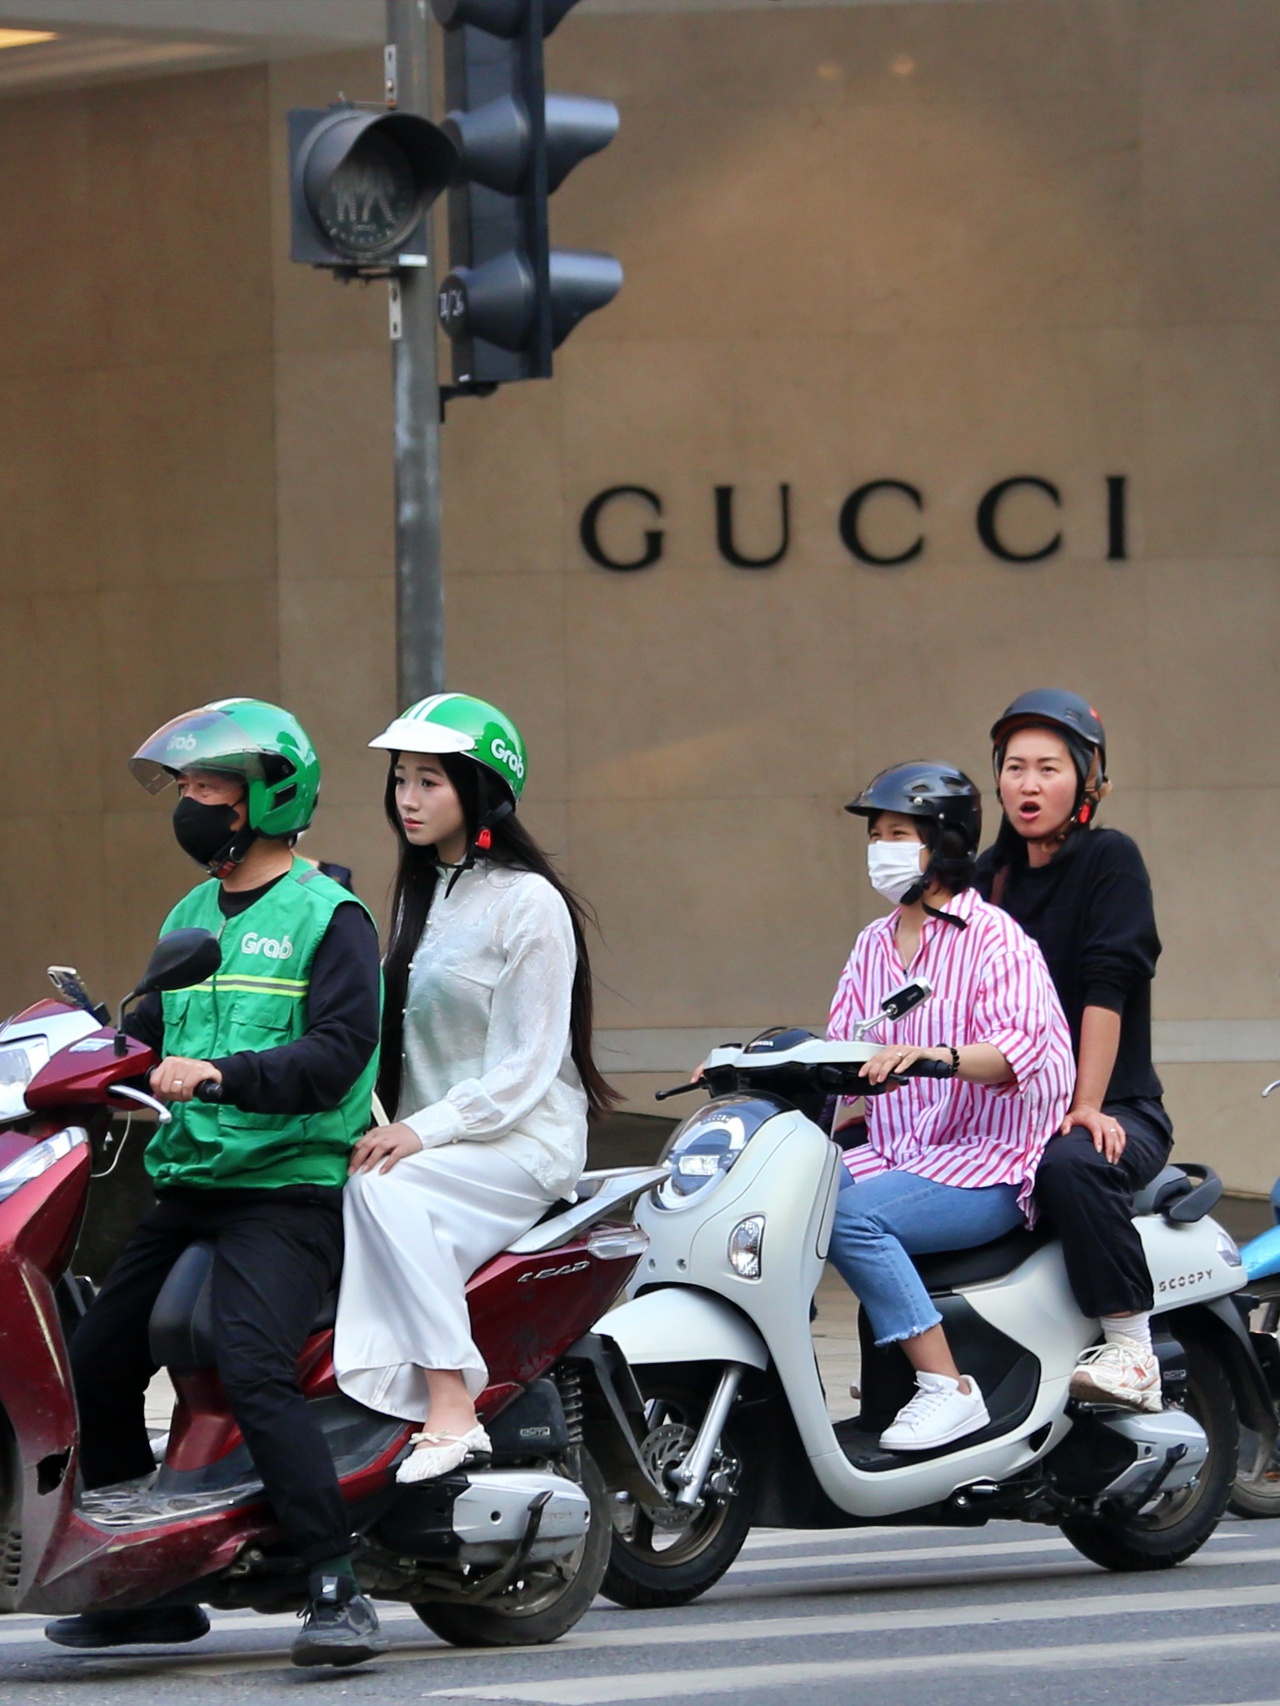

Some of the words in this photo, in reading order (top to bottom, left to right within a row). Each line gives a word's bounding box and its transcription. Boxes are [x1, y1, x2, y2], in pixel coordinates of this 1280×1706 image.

[580, 475, 1128, 573] GUCCI
[490, 738, 524, 779] Grab
[241, 931, 293, 960] Grab
[1158, 1269, 1213, 1293] SCOOPY
